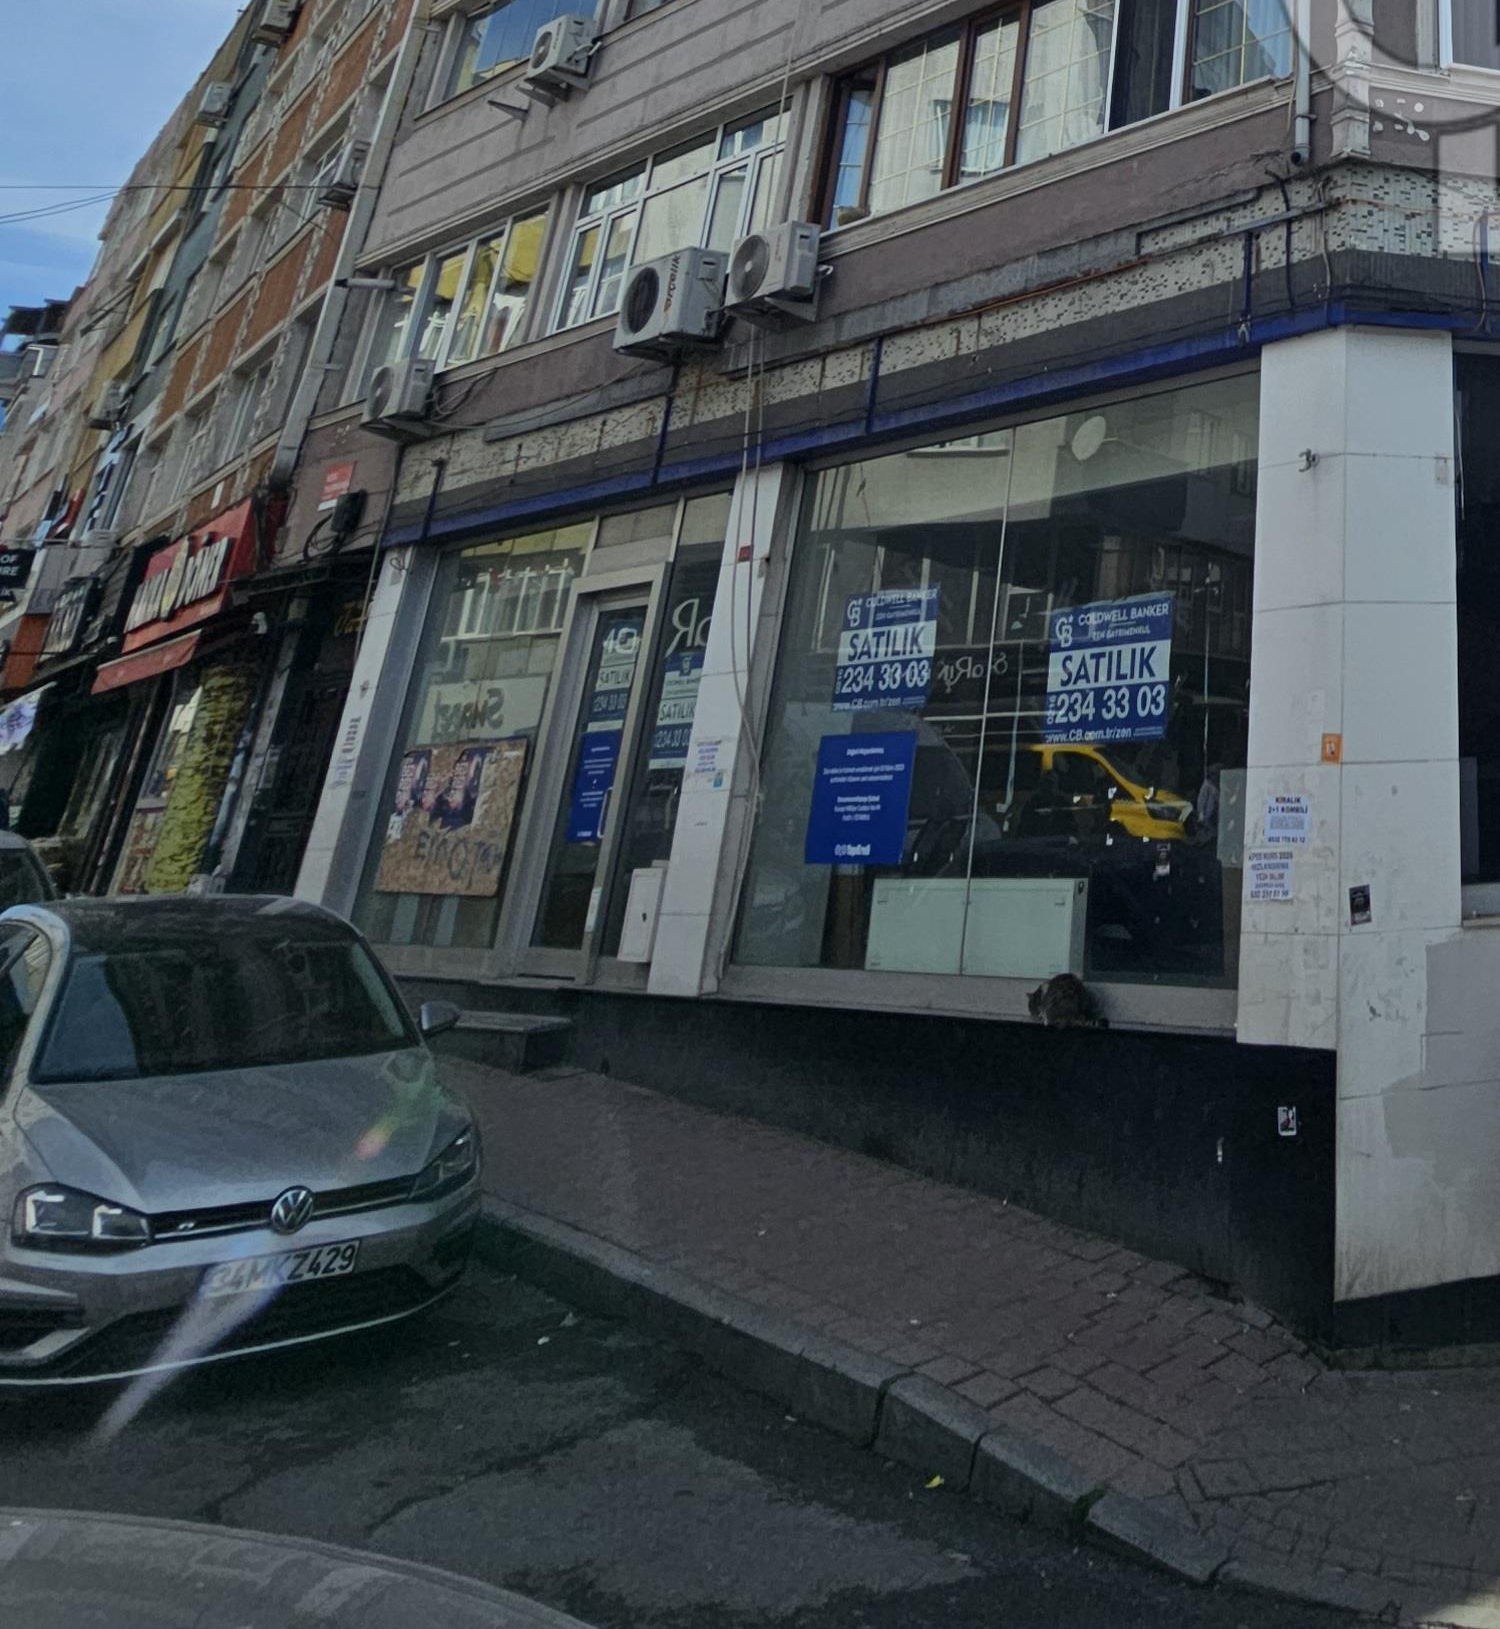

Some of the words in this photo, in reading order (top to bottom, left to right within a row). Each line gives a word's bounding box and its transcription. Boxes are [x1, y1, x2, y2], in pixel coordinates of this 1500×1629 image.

[1078, 610, 1128, 626] COLDWELL
[1131, 602, 1169, 620] BANKER
[848, 625, 924, 662] SATILIK
[841, 664, 875, 693] 234
[878, 662, 901, 690] 33
[905, 659, 930, 688] 03
[1060, 645, 1157, 688] SATILIK
[659, 698, 695, 722] SATILIK
[1054, 690, 1096, 724] 234
[1101, 687, 1130, 720] 33
[1136, 684, 1166, 717] 03
